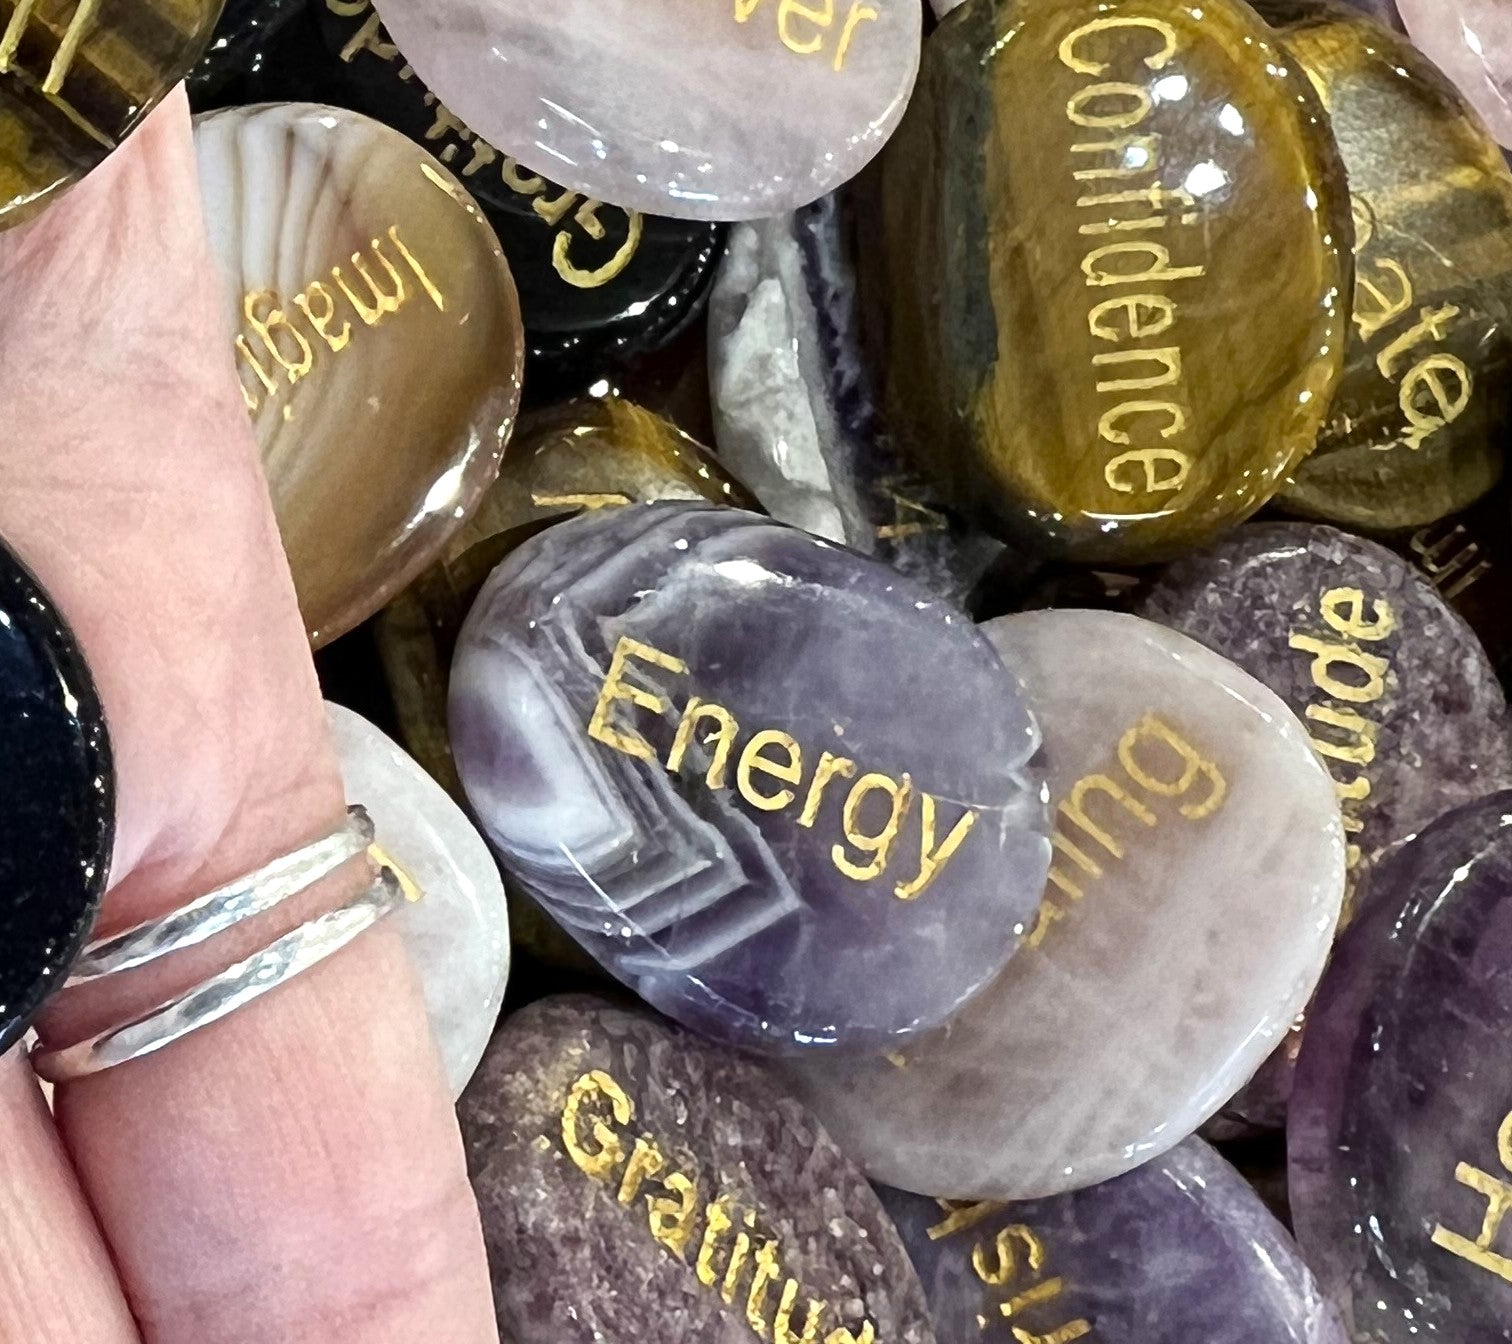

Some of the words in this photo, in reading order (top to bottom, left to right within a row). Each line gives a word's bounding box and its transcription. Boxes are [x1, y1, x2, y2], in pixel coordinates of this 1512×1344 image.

[234, 223, 445, 422] Imagi
[1059, 16, 1206, 495] Confidence
[588, 636, 981, 900] Energy
